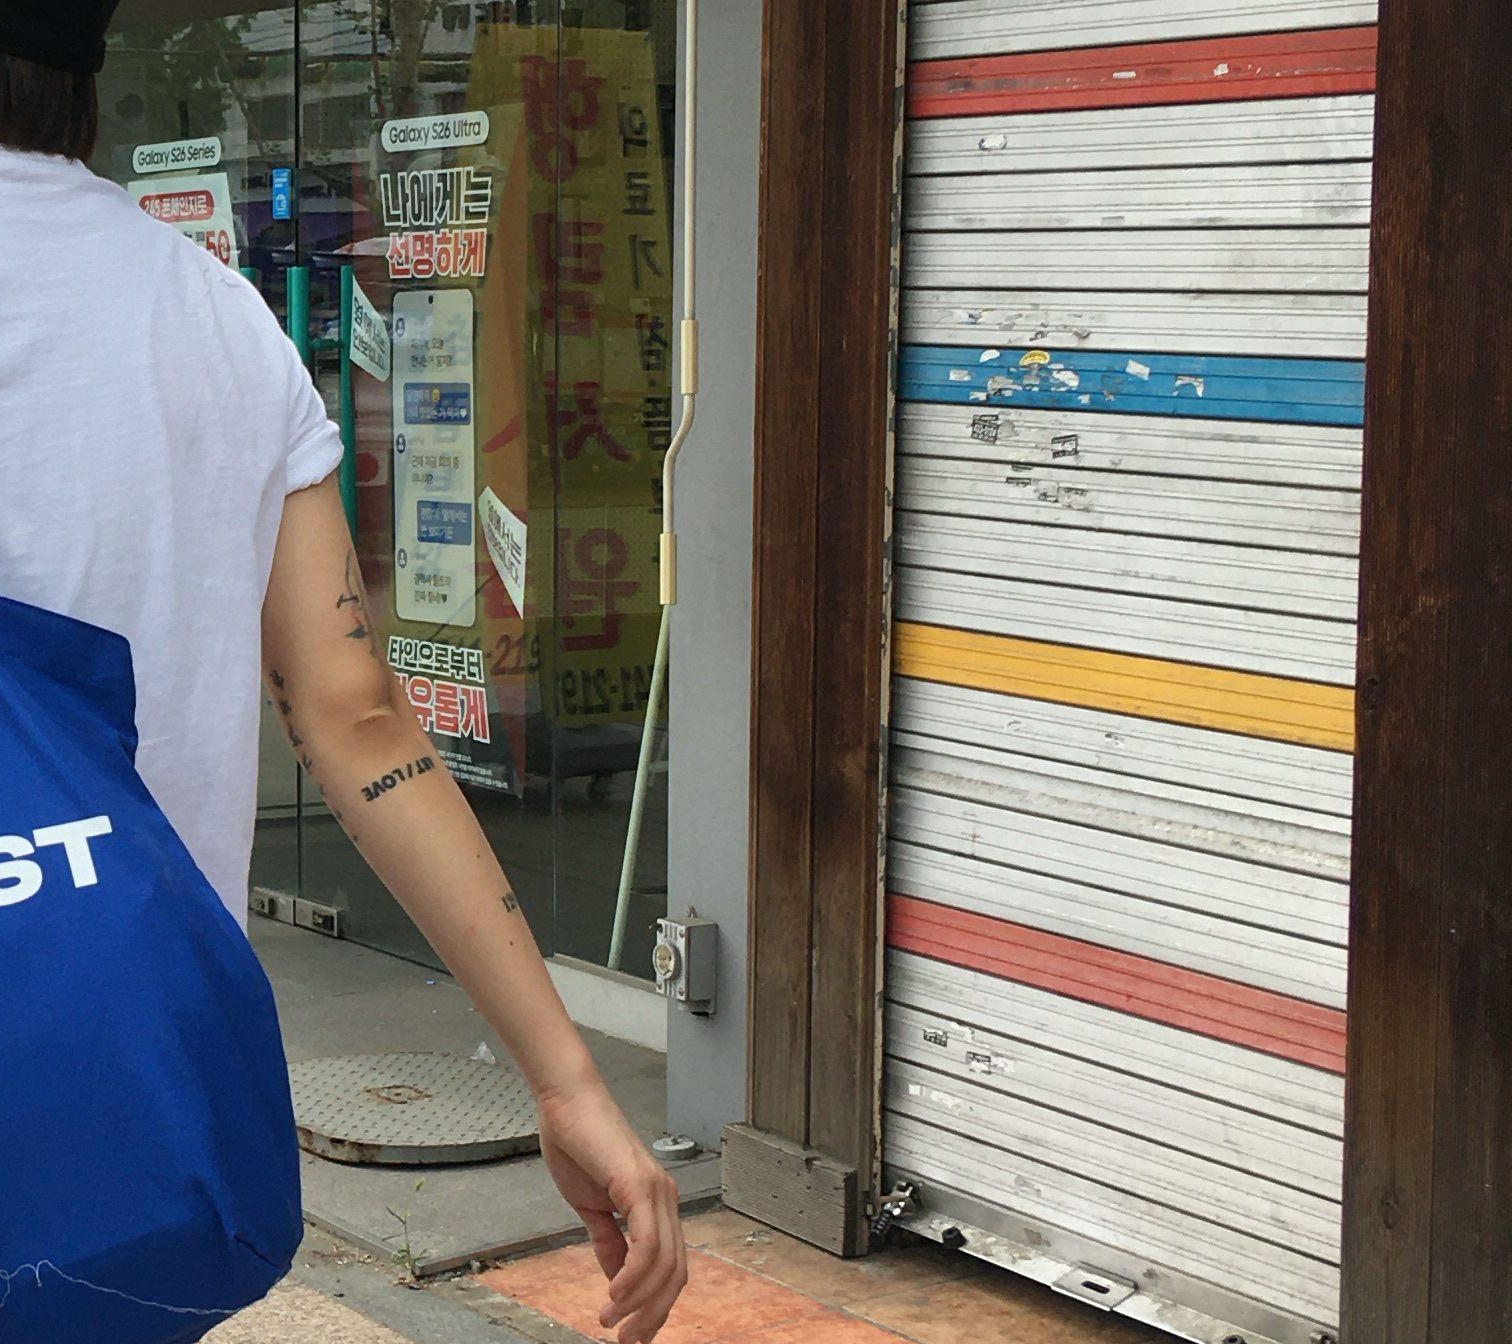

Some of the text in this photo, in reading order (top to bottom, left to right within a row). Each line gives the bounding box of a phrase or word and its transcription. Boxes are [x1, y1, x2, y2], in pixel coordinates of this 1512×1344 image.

[138, 143, 216, 167] Galaxy S26 Series
[390, 120, 481, 145] Galaxy S26 Ultra
[381, 166, 491, 226] 나에게는
[386, 228, 487, 278] 선명하게
[388, 636, 484, 683] 타인으로부터
